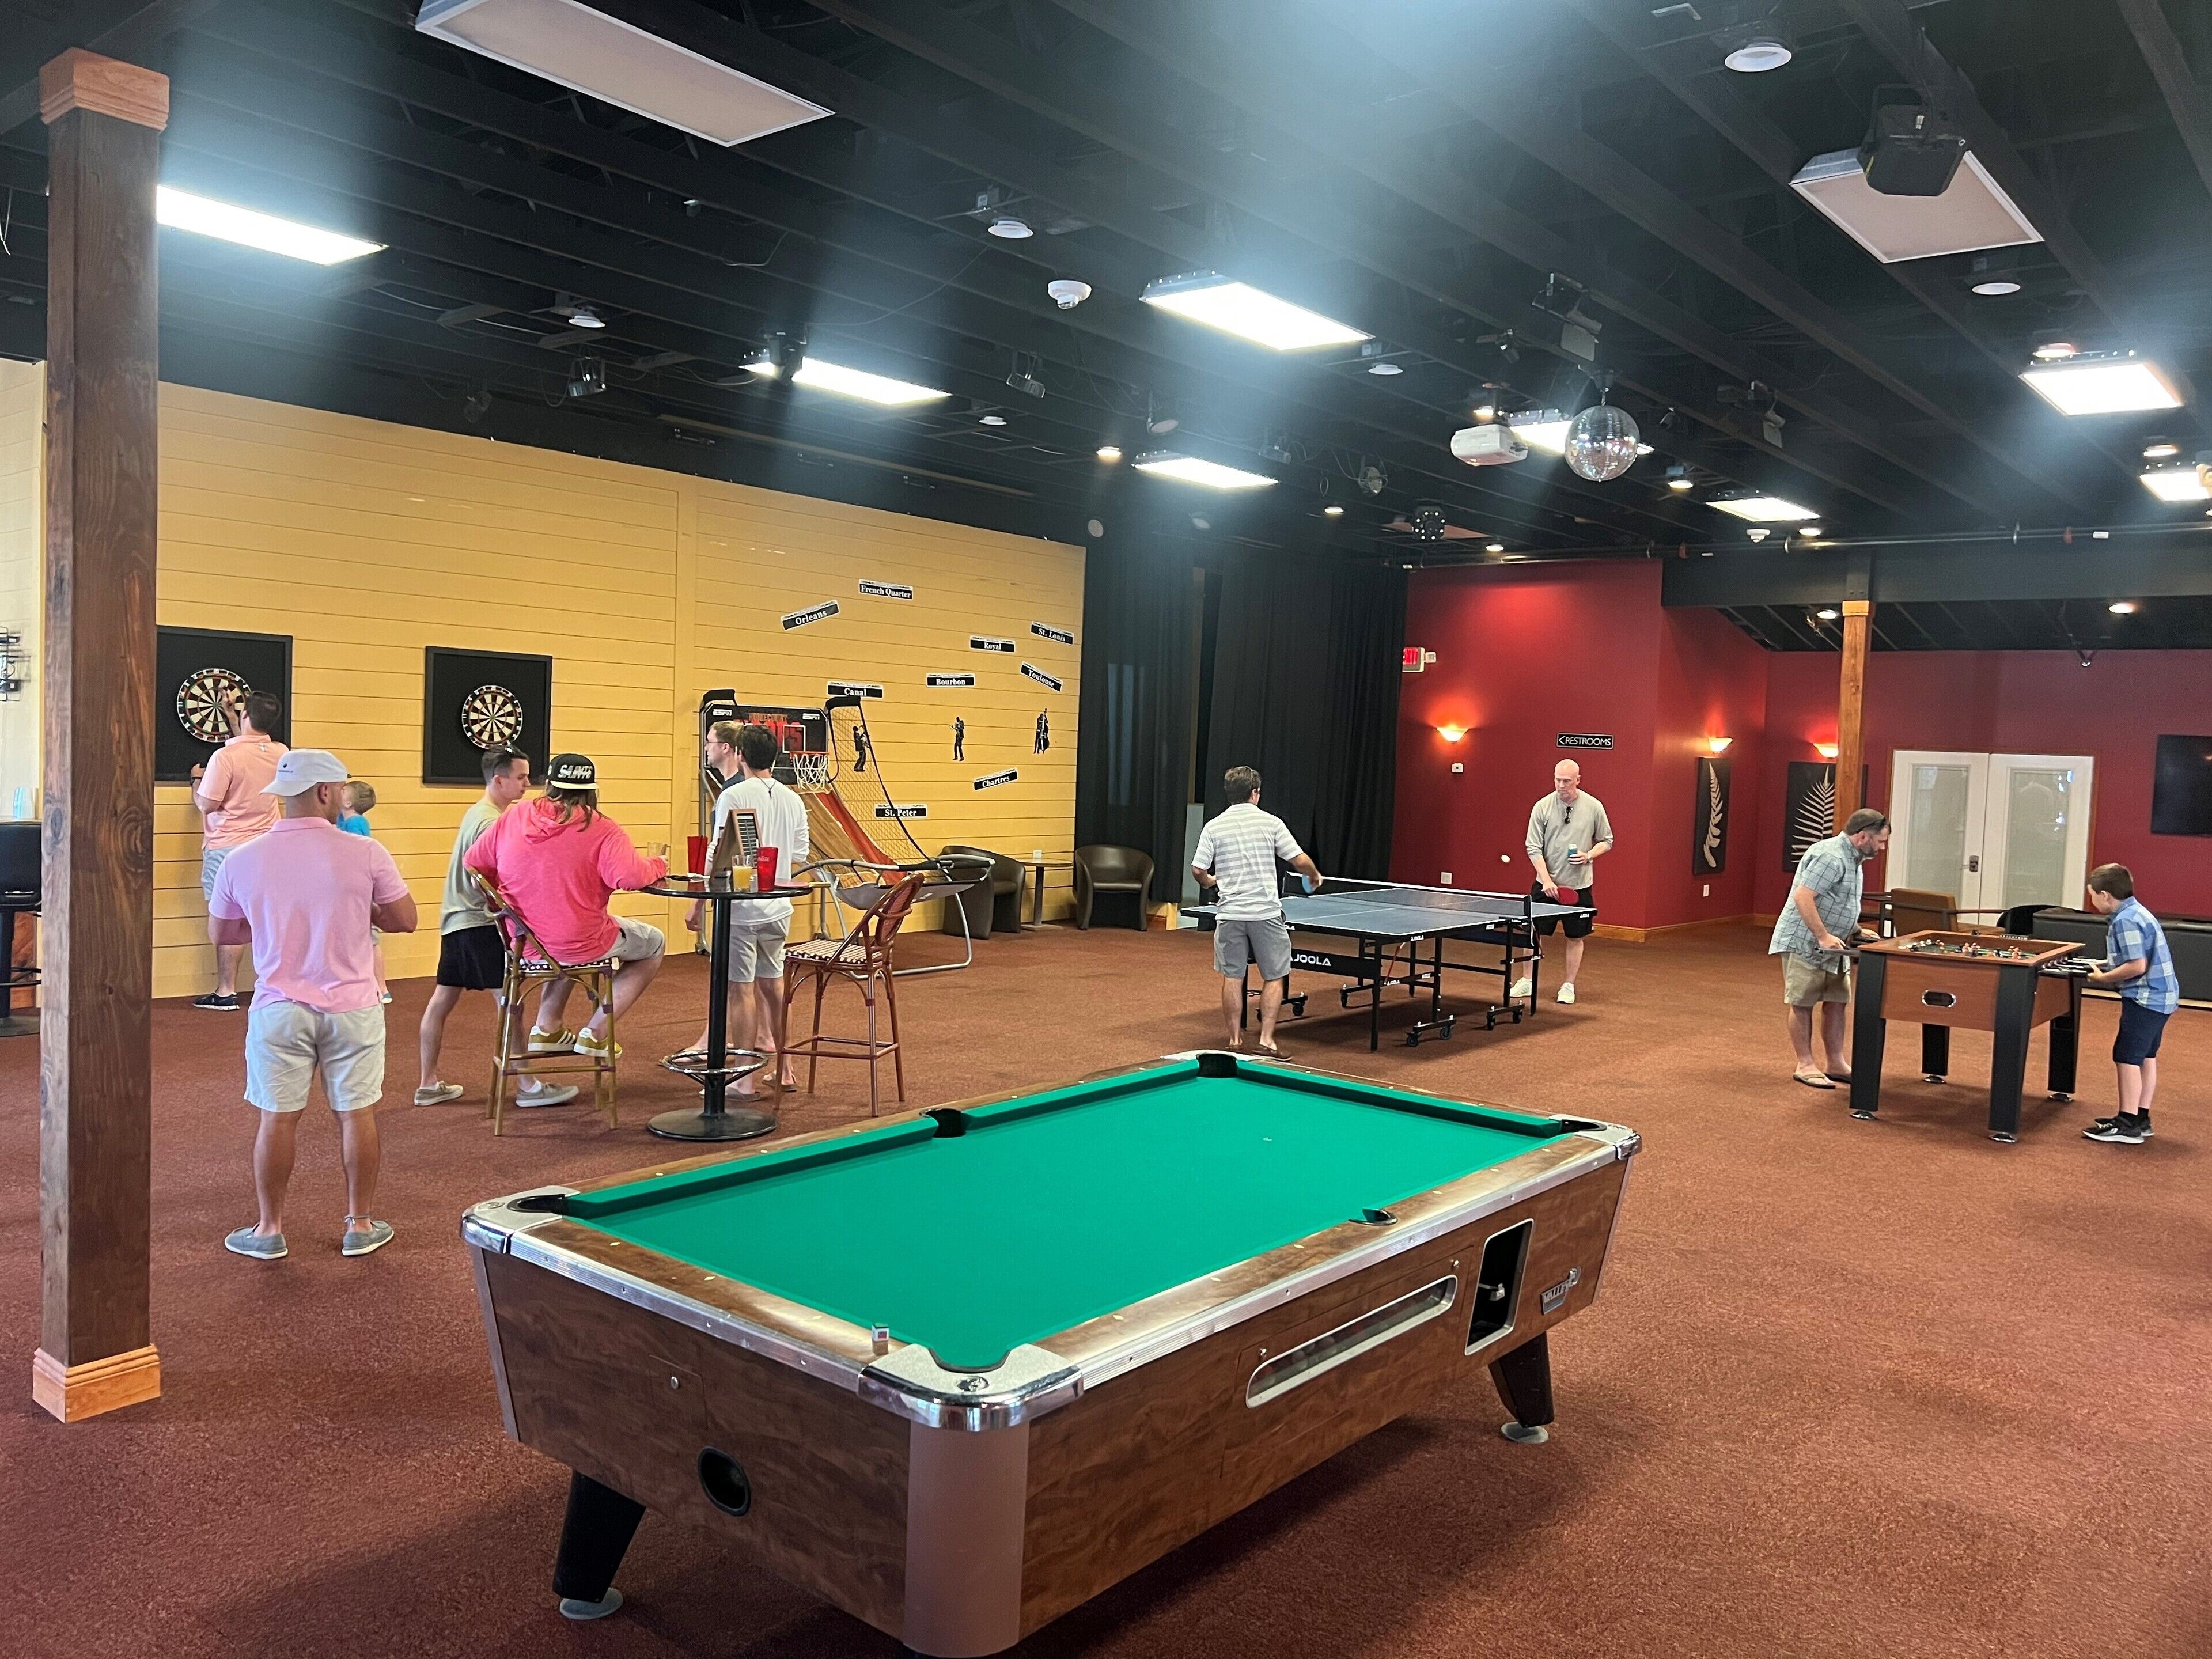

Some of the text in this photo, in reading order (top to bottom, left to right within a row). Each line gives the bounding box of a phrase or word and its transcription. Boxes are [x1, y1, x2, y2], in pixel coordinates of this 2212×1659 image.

[861, 585, 911, 599] French Quarter
[795, 609, 827, 626] Orleans
[1038, 628, 1066, 642] St. Louis
[984, 642, 1002, 651] Royal
[1028, 669, 1055, 688] Toulouse
[844, 687, 867, 696] Canal
[713, 709, 732, 717] ESPN
[1565, 736, 1611, 747] RESTROOMS
[982, 775, 1010, 788] Chartres
[1294, 953, 1332, 967] JOOLA
